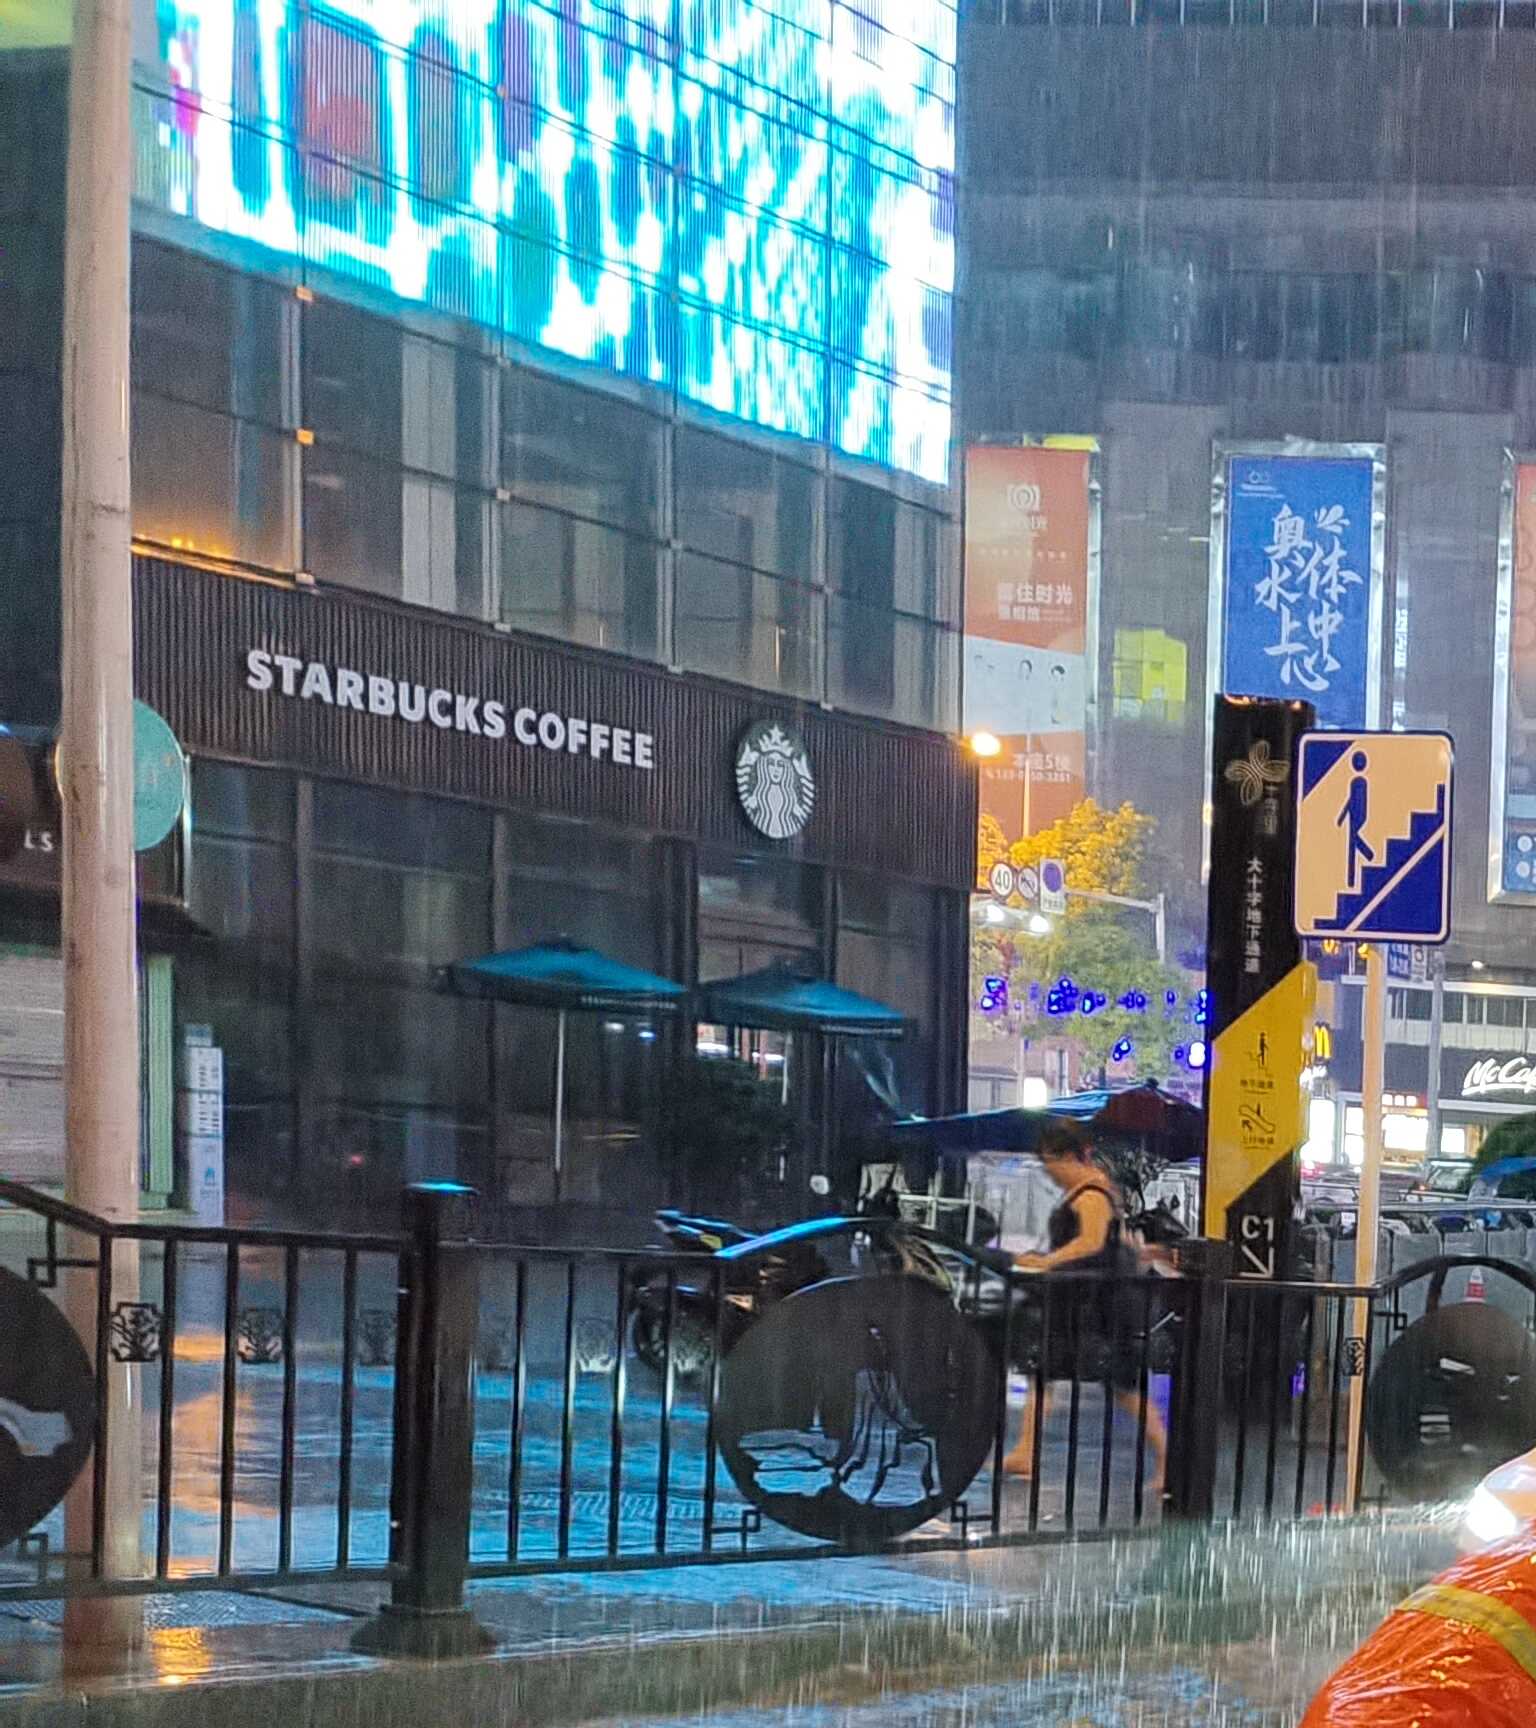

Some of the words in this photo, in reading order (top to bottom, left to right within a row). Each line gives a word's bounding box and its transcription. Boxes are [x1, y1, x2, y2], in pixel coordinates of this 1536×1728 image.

[246, 648, 507, 740] STARBUCKS
[513, 707, 656, 770] COFFEE
[994, 871, 1011, 893] 40
[1241, 1215, 1275, 1242] C1
